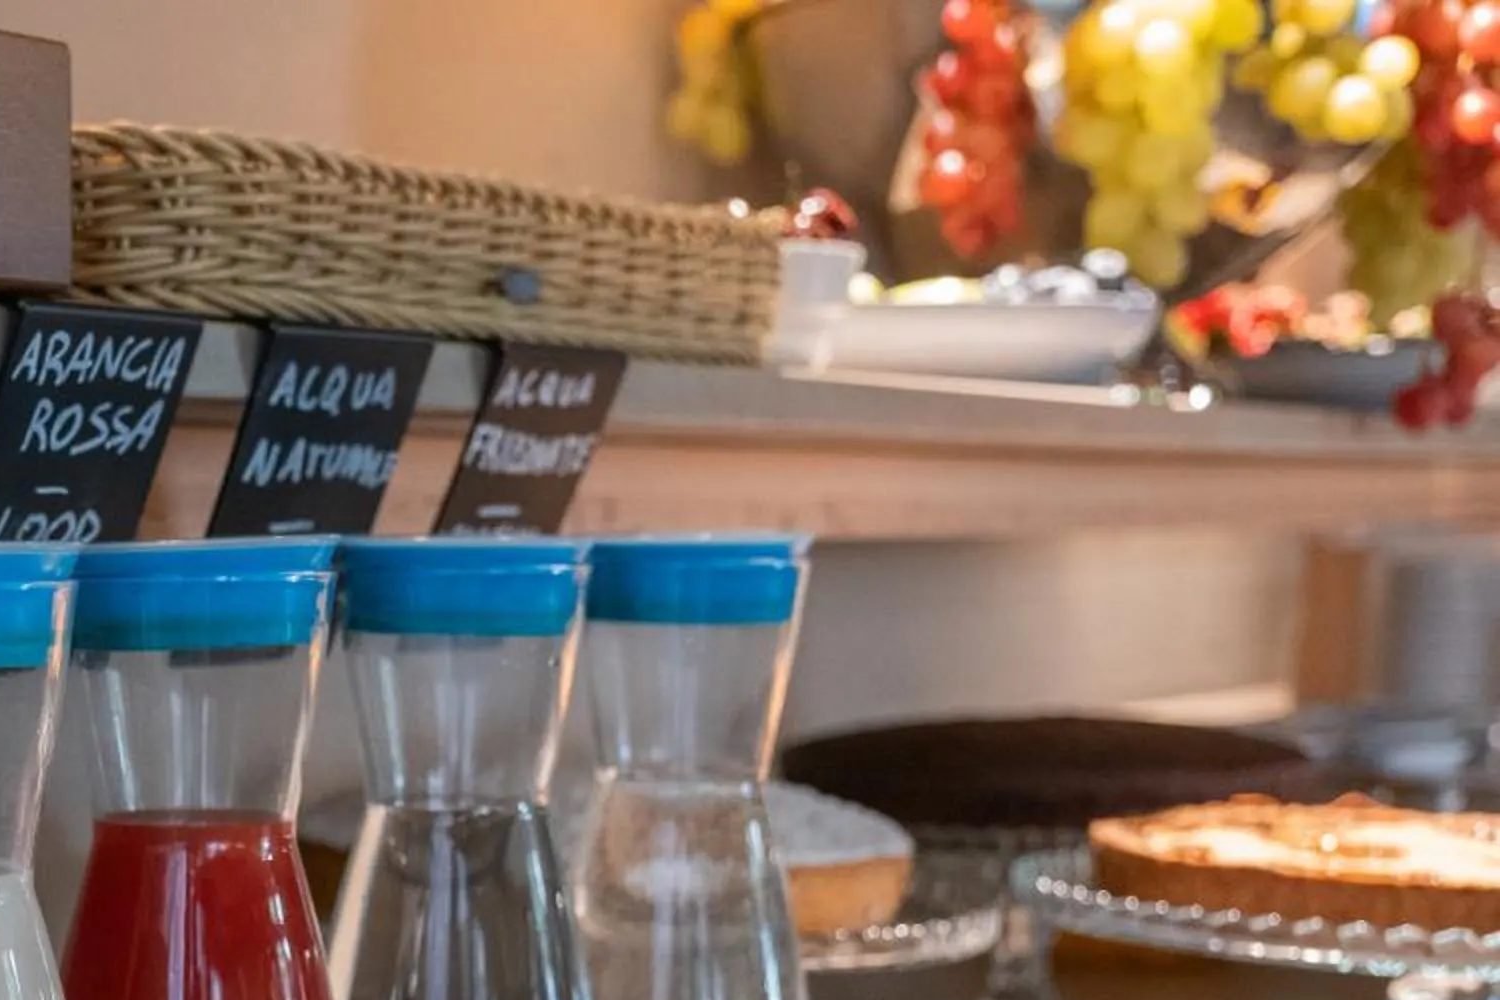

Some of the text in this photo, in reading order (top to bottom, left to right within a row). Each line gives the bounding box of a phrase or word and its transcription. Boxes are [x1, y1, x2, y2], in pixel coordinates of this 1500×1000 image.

[10, 329, 187, 393] ARANCIA
[267, 360, 397, 417] ACQUA
[19, 397, 166, 457] ROSSA
